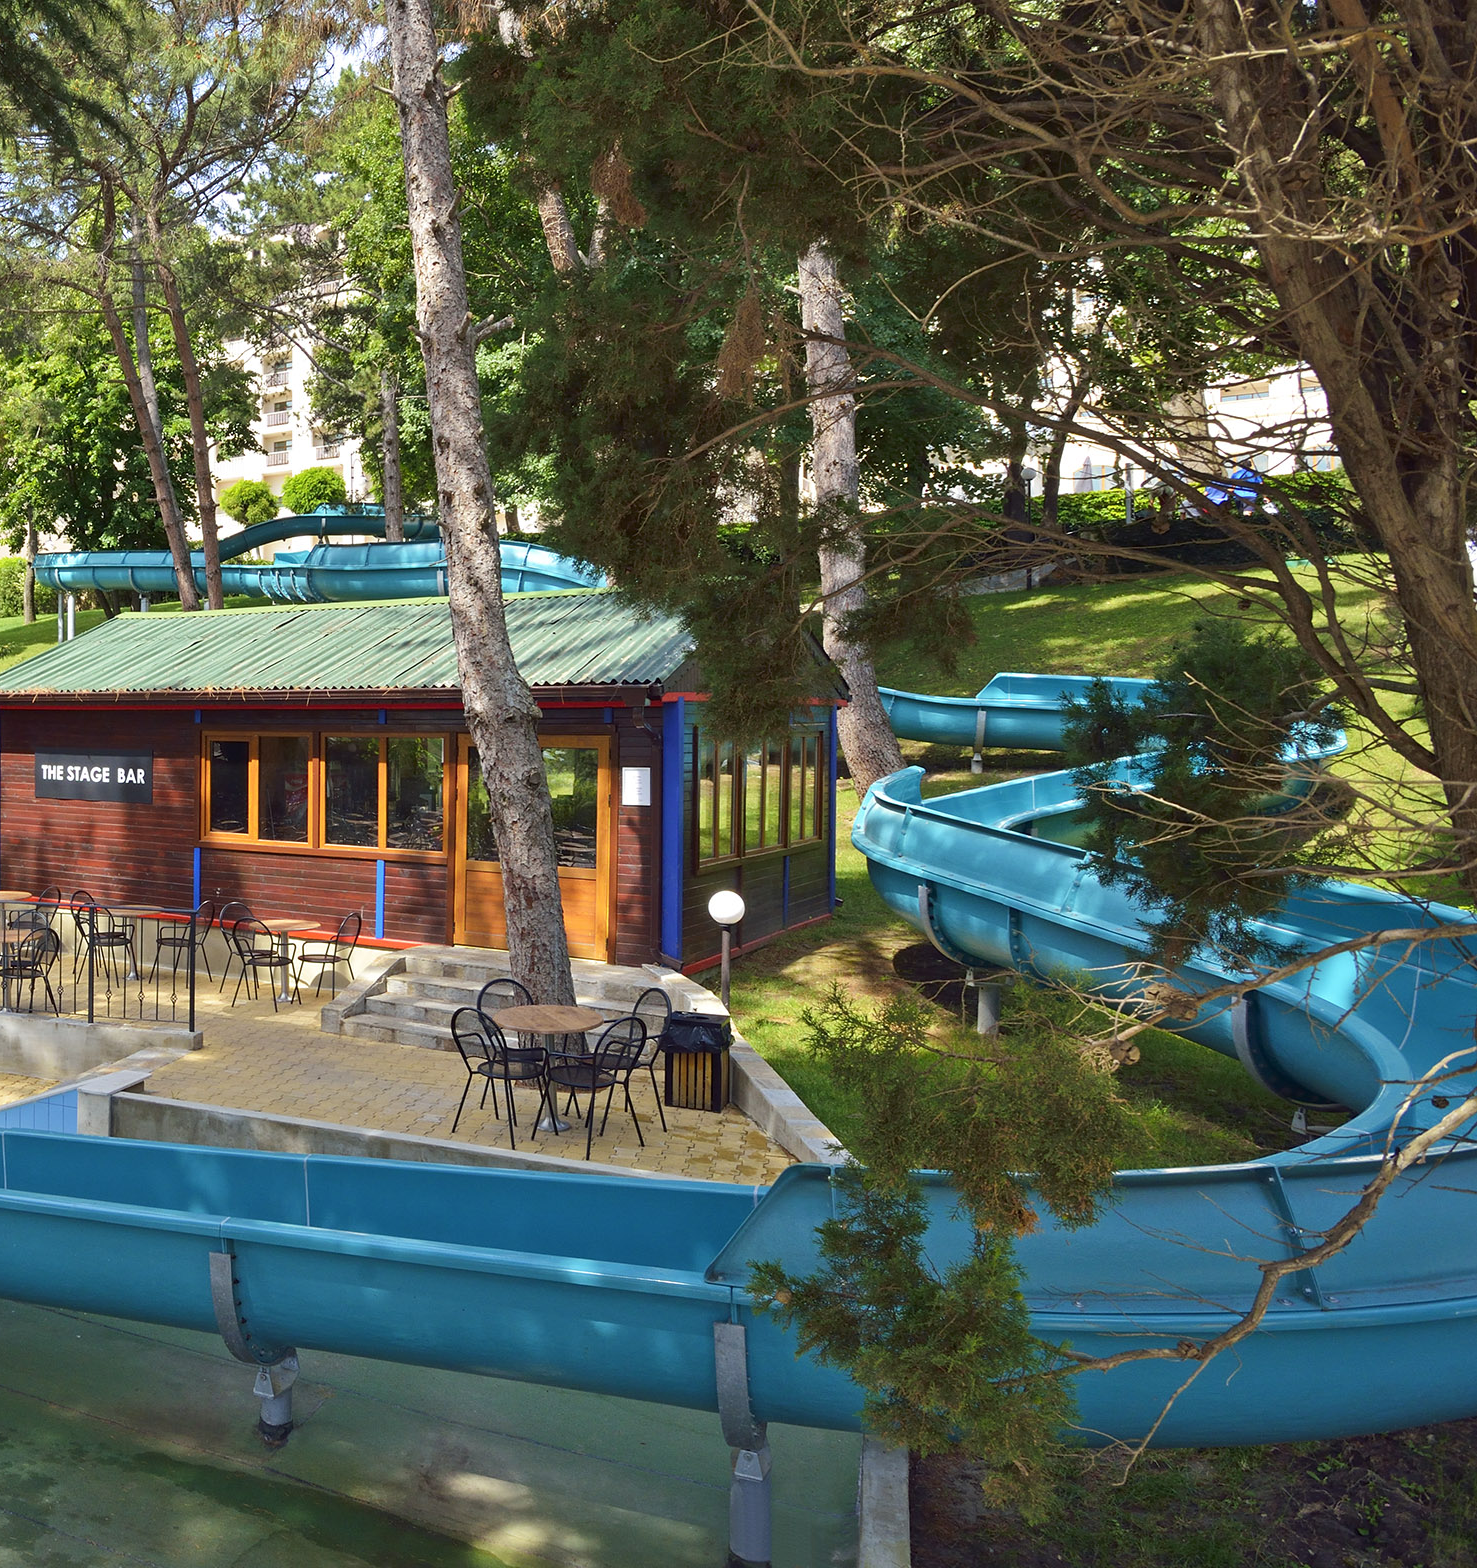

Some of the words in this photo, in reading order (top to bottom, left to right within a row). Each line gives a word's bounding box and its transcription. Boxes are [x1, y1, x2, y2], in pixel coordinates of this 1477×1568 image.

[41, 764, 64, 780] THE
[66, 765, 110, 783] STAGE
[117, 768, 145, 784] BAR
